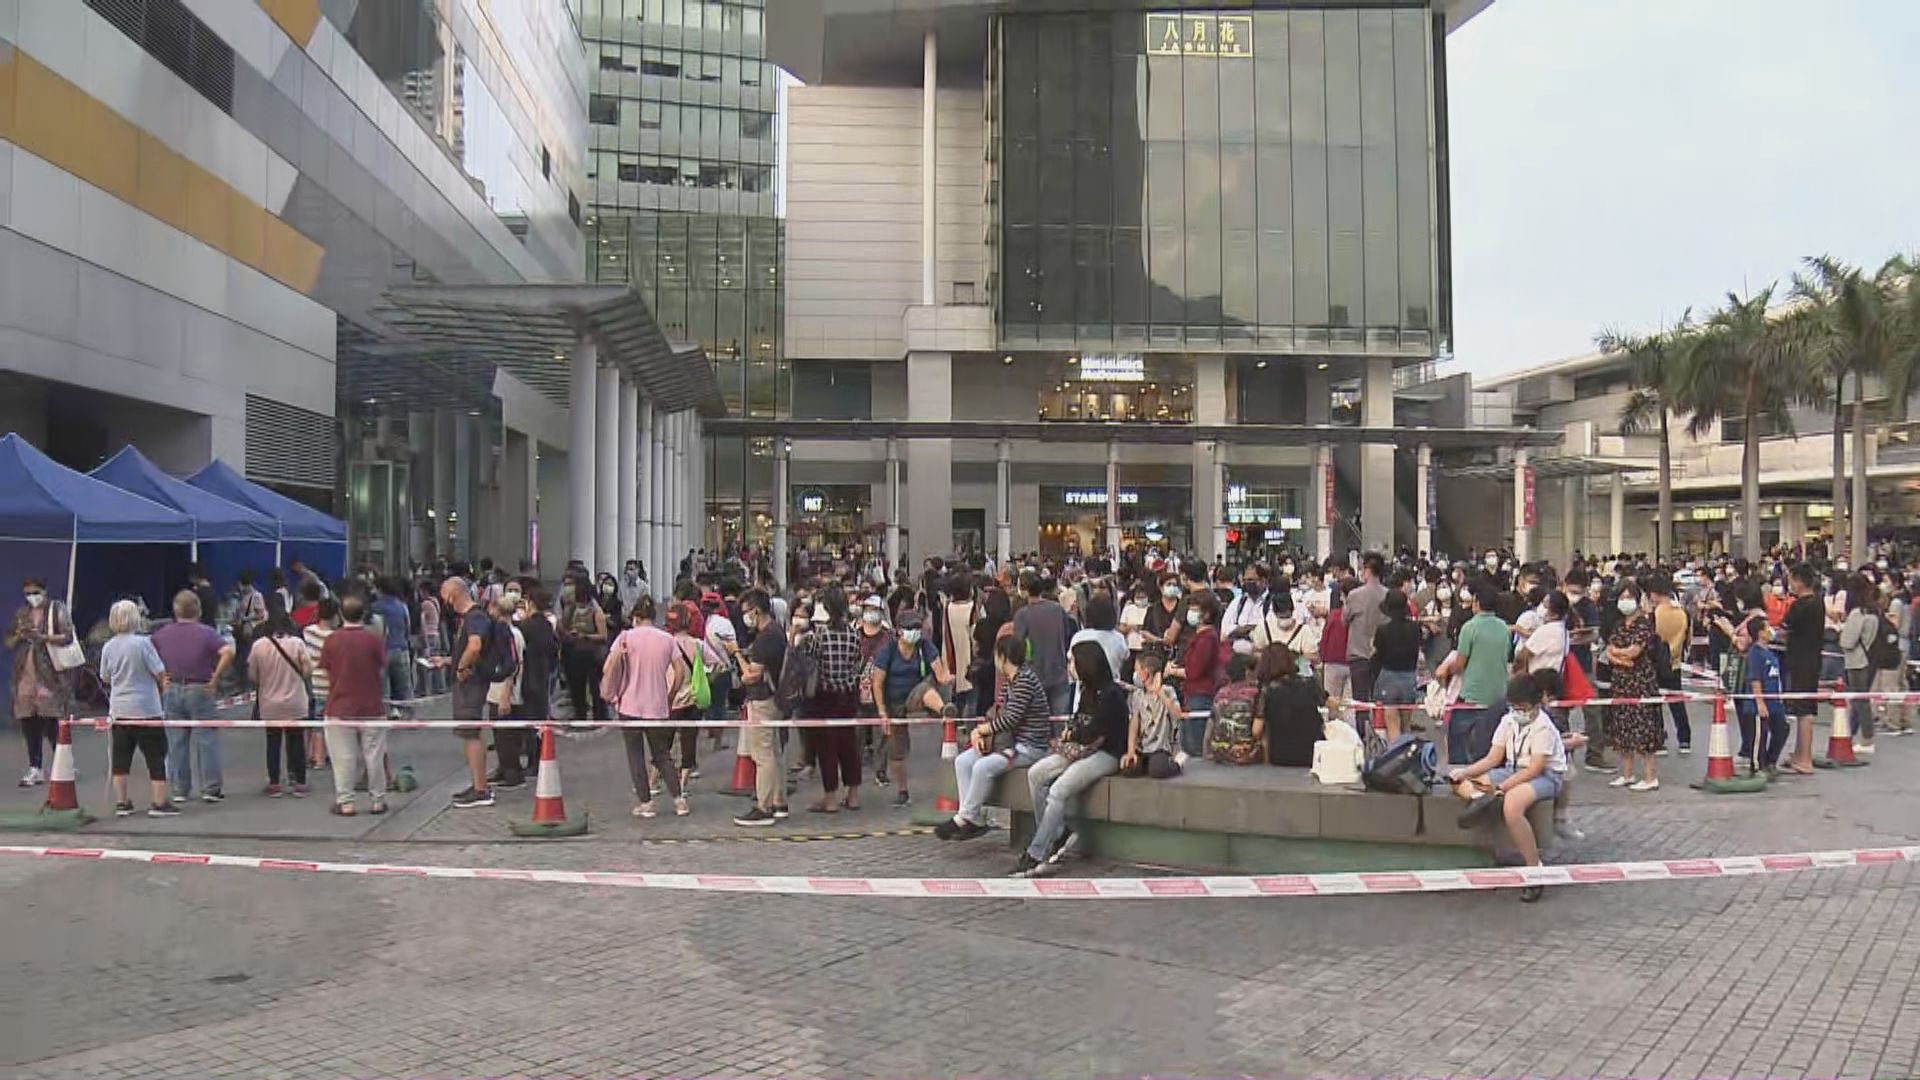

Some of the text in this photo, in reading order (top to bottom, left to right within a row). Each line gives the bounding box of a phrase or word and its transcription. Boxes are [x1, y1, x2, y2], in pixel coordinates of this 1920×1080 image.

[1164, 20, 1234, 42] 八月花
[1065, 492, 1138, 503] STARBKS
